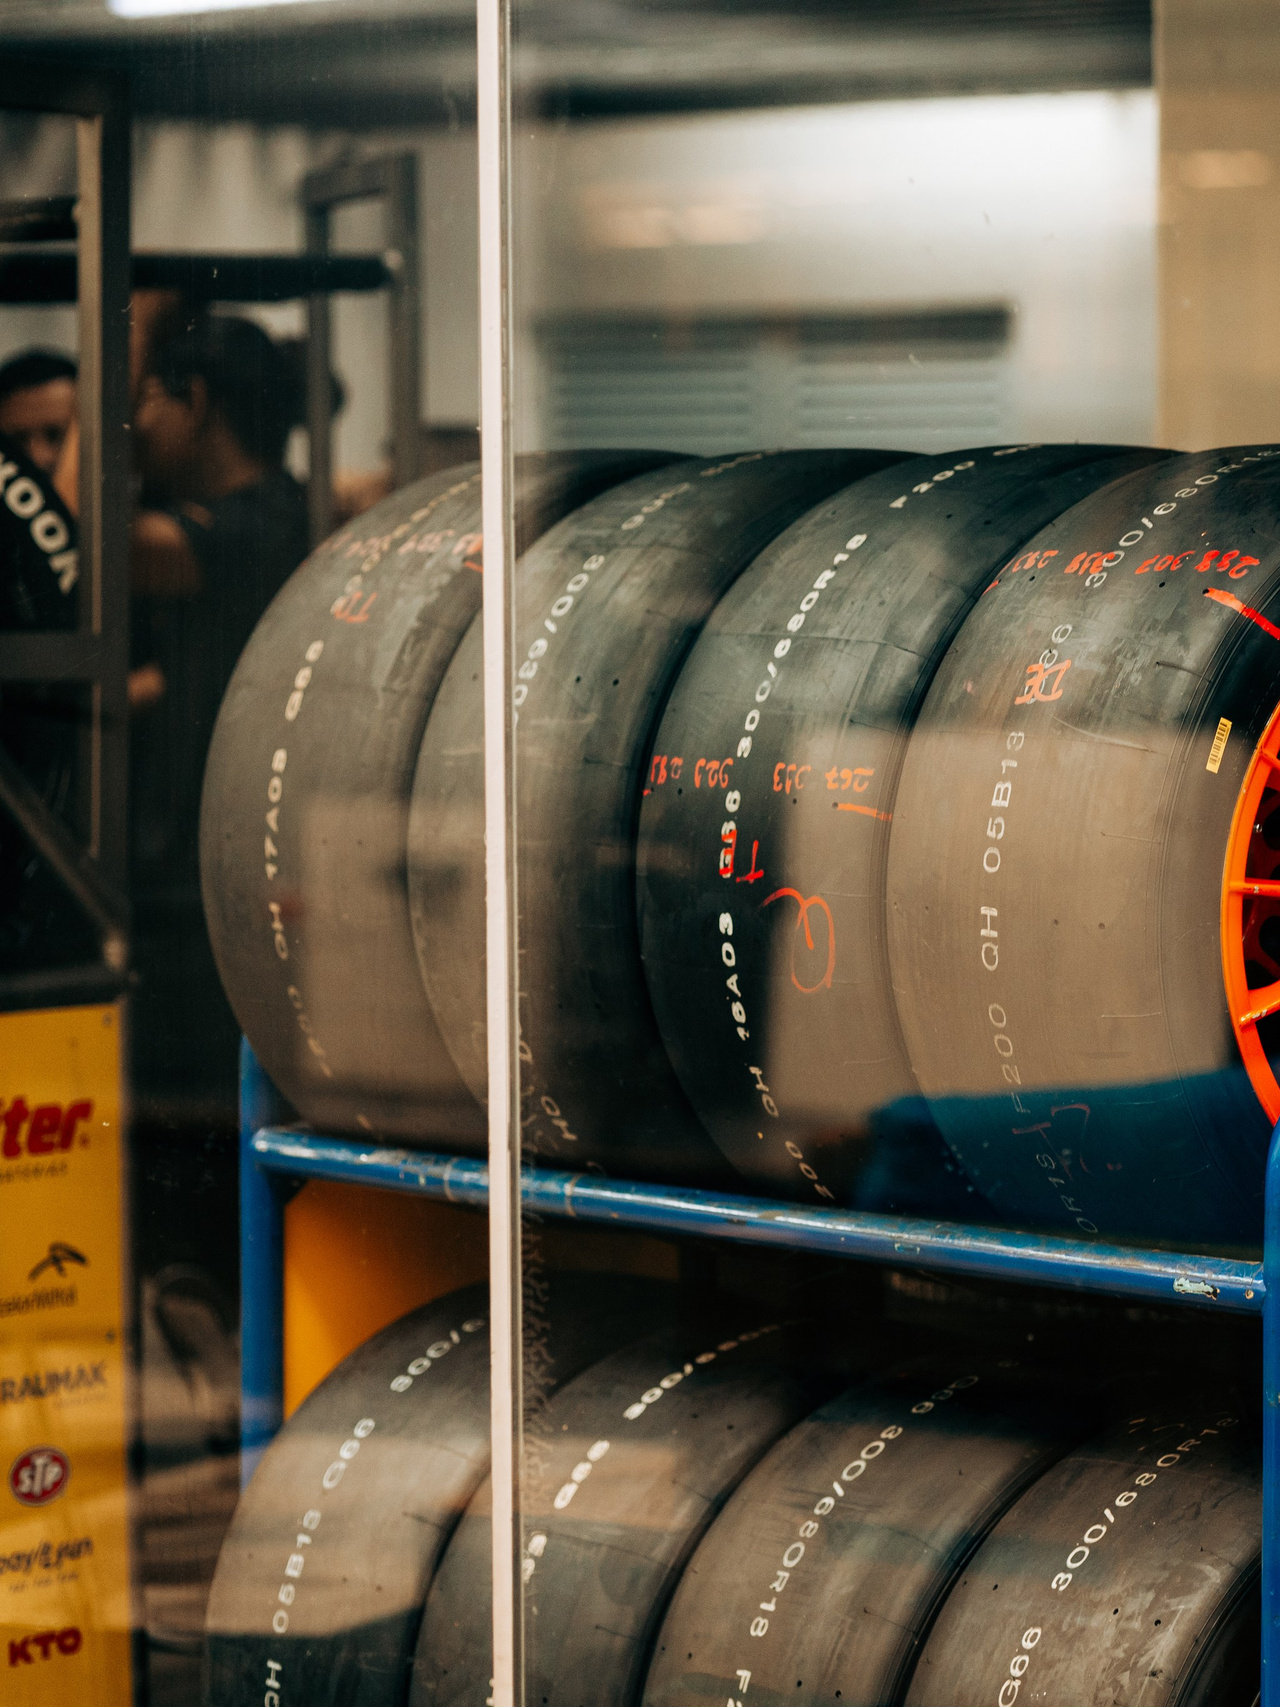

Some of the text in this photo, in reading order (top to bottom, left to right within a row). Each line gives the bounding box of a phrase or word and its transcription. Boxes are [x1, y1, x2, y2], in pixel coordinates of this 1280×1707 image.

[737, 533, 868, 759] 300/680R18
[980, 730, 1026, 873] 05B13
[980, 905, 1000, 972] QH
[18, 1456, 63, 1497] STP
[749, 1425, 903, 1638] 300/680R18
[1050, 1416, 1239, 1591] 300/680R18
[8, 1627, 82, 1668] KTO
